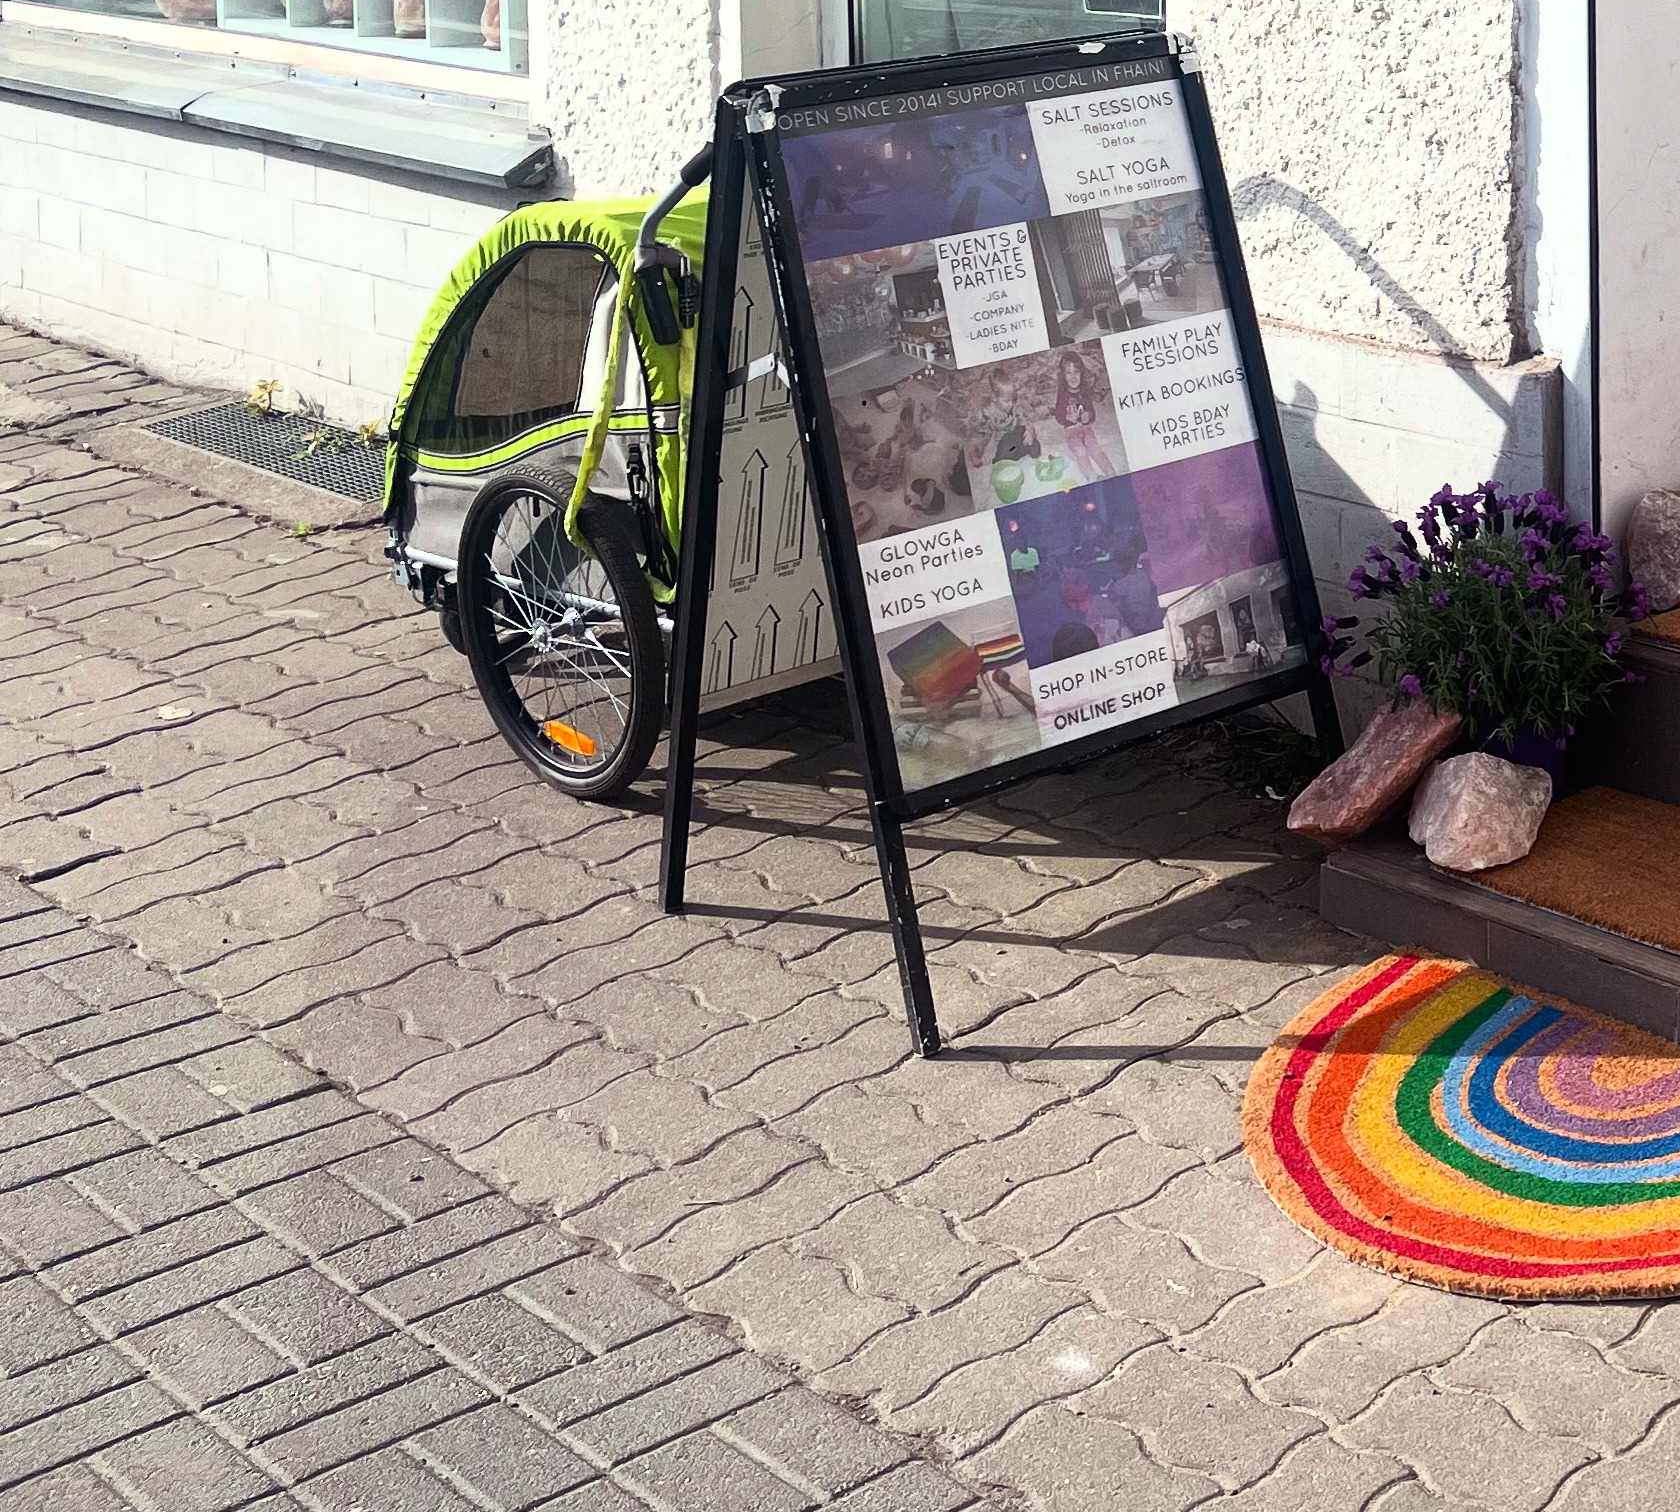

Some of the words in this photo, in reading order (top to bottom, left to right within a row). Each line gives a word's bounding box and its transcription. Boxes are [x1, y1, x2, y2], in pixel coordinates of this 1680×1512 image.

[777, 109, 830, 131] OPEN
[835, 99, 893, 123] SINCE
[898, 94, 942, 115] 2014!
[946, 79, 1026, 106] SUPPORT
[1032, 71, 1089, 94] LOCAL
[1093, 67, 1109, 84] IN
[1042, 105, 1082, 125] SALT
[1088, 91, 1174, 118] SESSIONS
[1076, 165, 1116, 185] SALT
[1121, 156, 1171, 177] YOGA
[1065, 191, 1096, 204] Yoga
[1099, 187, 1111, 199] in
[1114, 183, 1134, 196] the
[1137, 174, 1188, 192] saltroom
[938, 231, 1011, 260] EVENTS
[1016, 229, 1027, 244] &
[950, 246, 1024, 275] PRIVATE
[953, 263, 1027, 291] PARTIES
[1010, 318, 1035, 332] NITE
[1121, 332, 1179, 358] FAMILY
[1183, 322, 1222, 344] PLAY
[1133, 339, 1219, 372] SESSIONS
[1118, 389, 1157, 410] KITA
[1160, 367, 1246, 400] BOOKINGS
[1149, 414, 1189, 437] KIDS
[1193, 403, 1230, 426] BDAY
[1163, 422, 1226, 450] PARTIES
[880, 528, 965, 563] GLOWGA
[865, 563, 915, 587] Neon
[920, 544, 984, 571] Parties
[880, 593, 926, 619] KIDS
[930, 577, 983, 604] YOGA
[1039, 673, 1085, 700] SHOP
[1089, 646, 1169, 684] IN-STORE
[1053, 697, 1117, 731] ONLINE
[1121, 682, 1166, 709] SHOP
